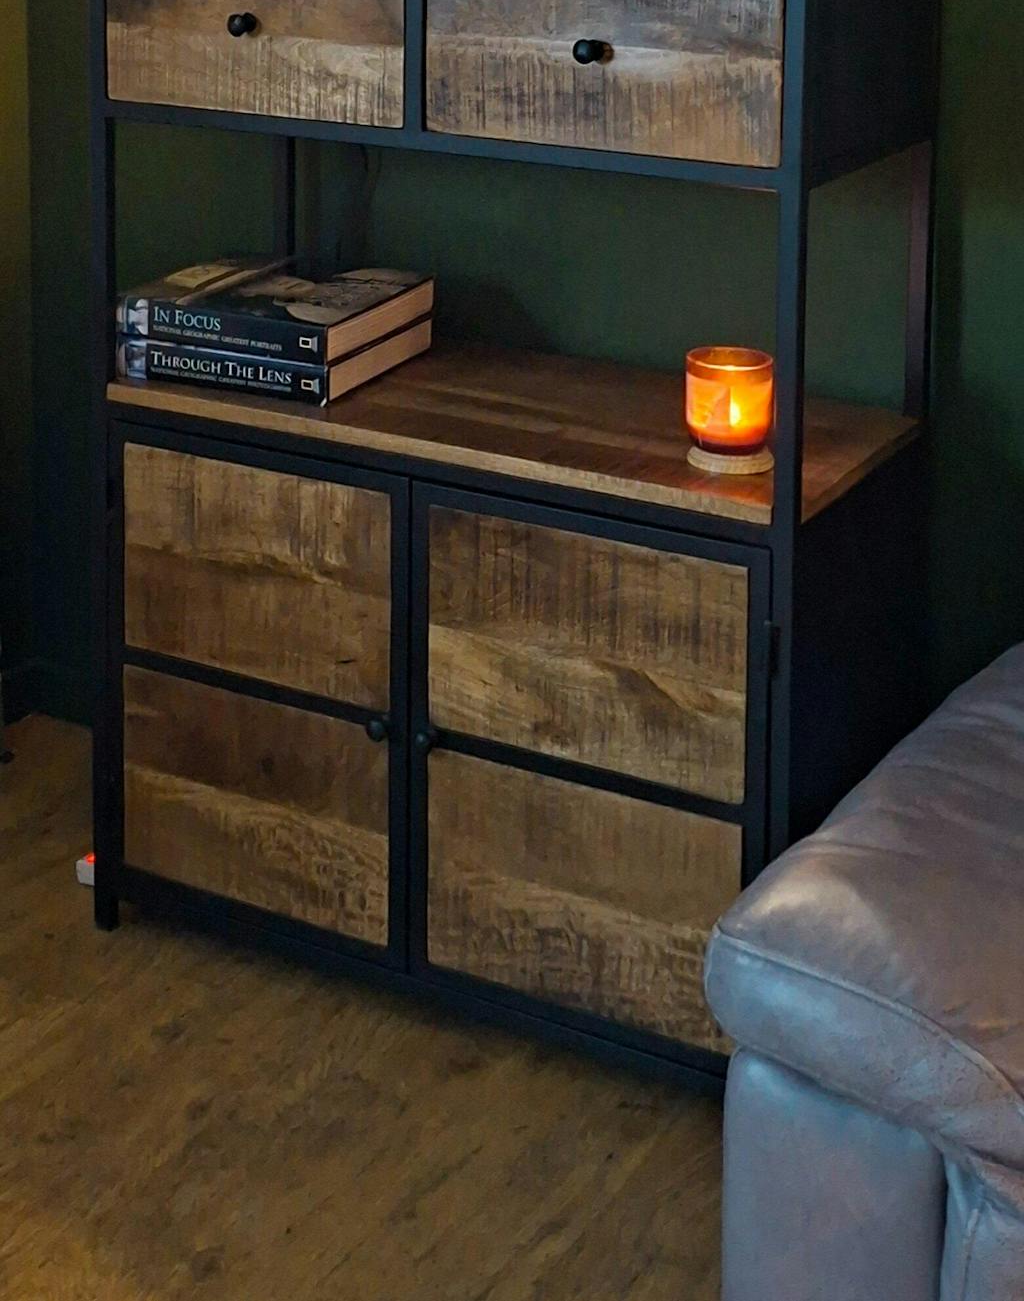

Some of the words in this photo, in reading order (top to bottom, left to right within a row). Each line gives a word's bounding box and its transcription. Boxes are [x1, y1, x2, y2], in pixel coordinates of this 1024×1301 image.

[153, 306, 170, 324] IN
[174, 309, 221, 331] FOCUS
[150, 350, 221, 374] THROUGH
[224, 360, 254, 380] THE
[258, 366, 292, 384] LENS
